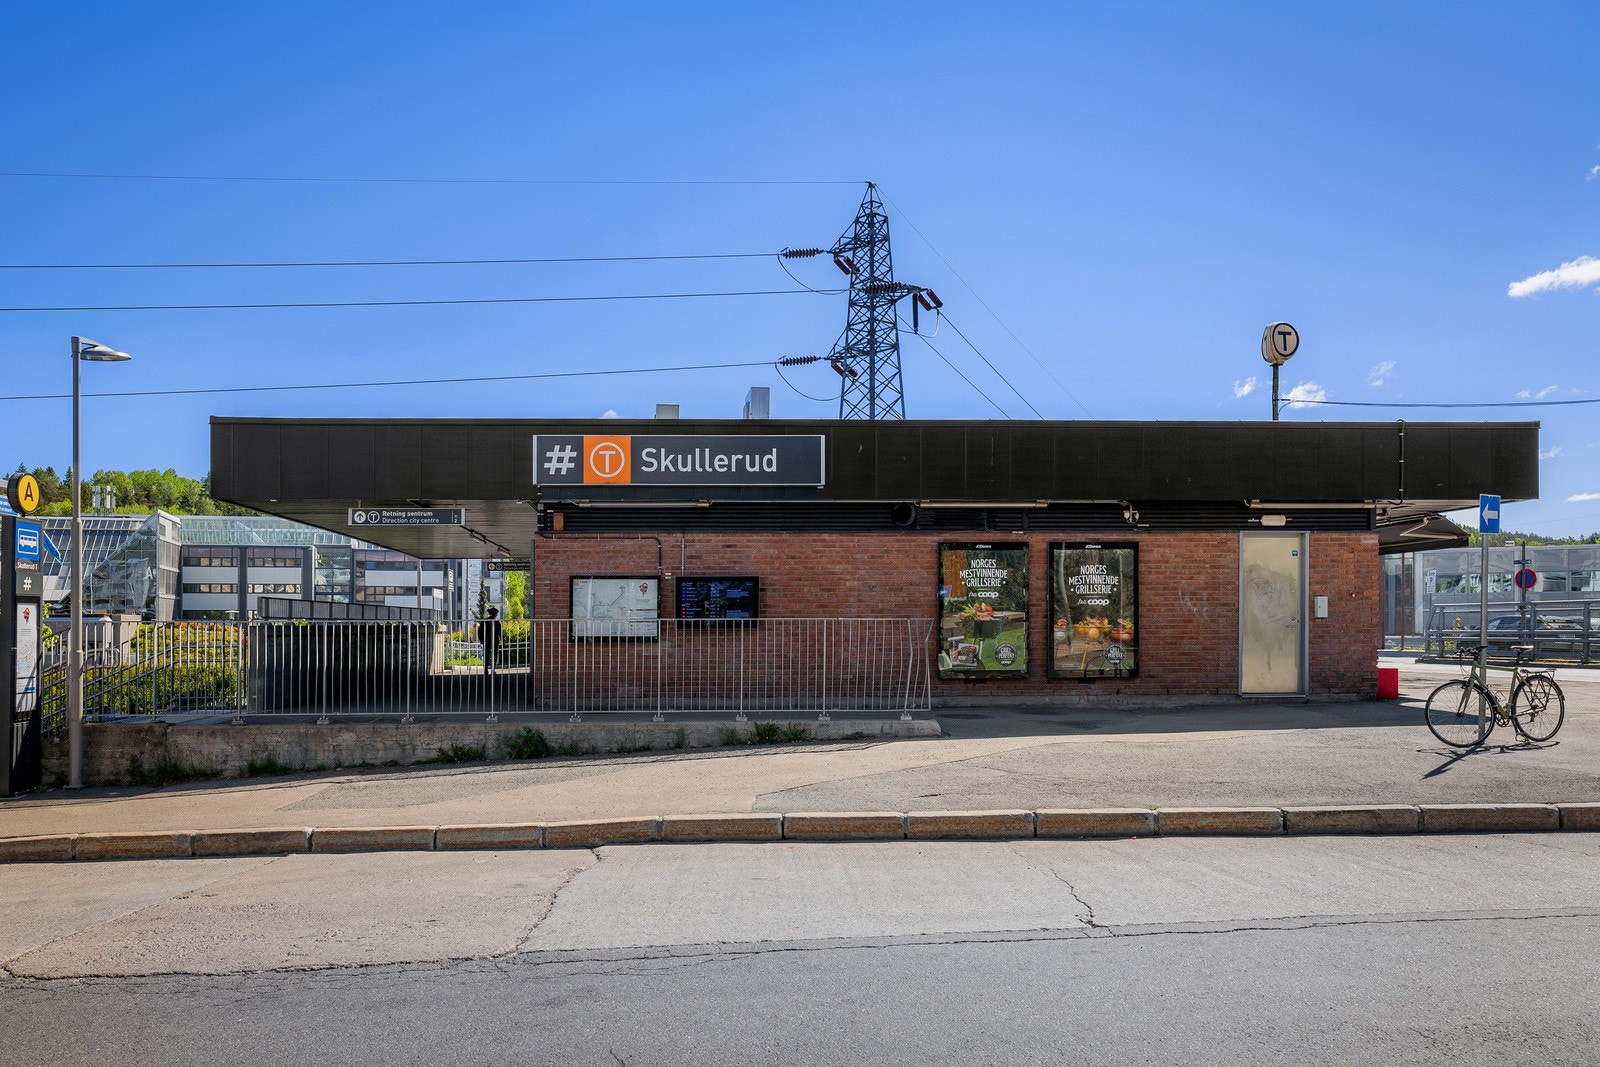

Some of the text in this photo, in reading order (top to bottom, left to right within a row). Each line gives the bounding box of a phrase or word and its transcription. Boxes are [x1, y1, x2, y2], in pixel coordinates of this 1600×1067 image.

[1278, 331, 1291, 351] T
[544, 445, 777, 475] # T Skullerud
[24, 482, 34, 501] A
[971, 559, 997, 568] NORGES
[960, 569, 1008, 578] MESTVINNENDE
[1080, 565, 1107, 574] NORGES
[966, 578, 1002, 587] GRILLSERIE
[1069, 575, 1119, 585] MESTVINNENDE
[1075, 585, 1112, 594] GRILLSERIE
[978, 591, 999, 599] coop
